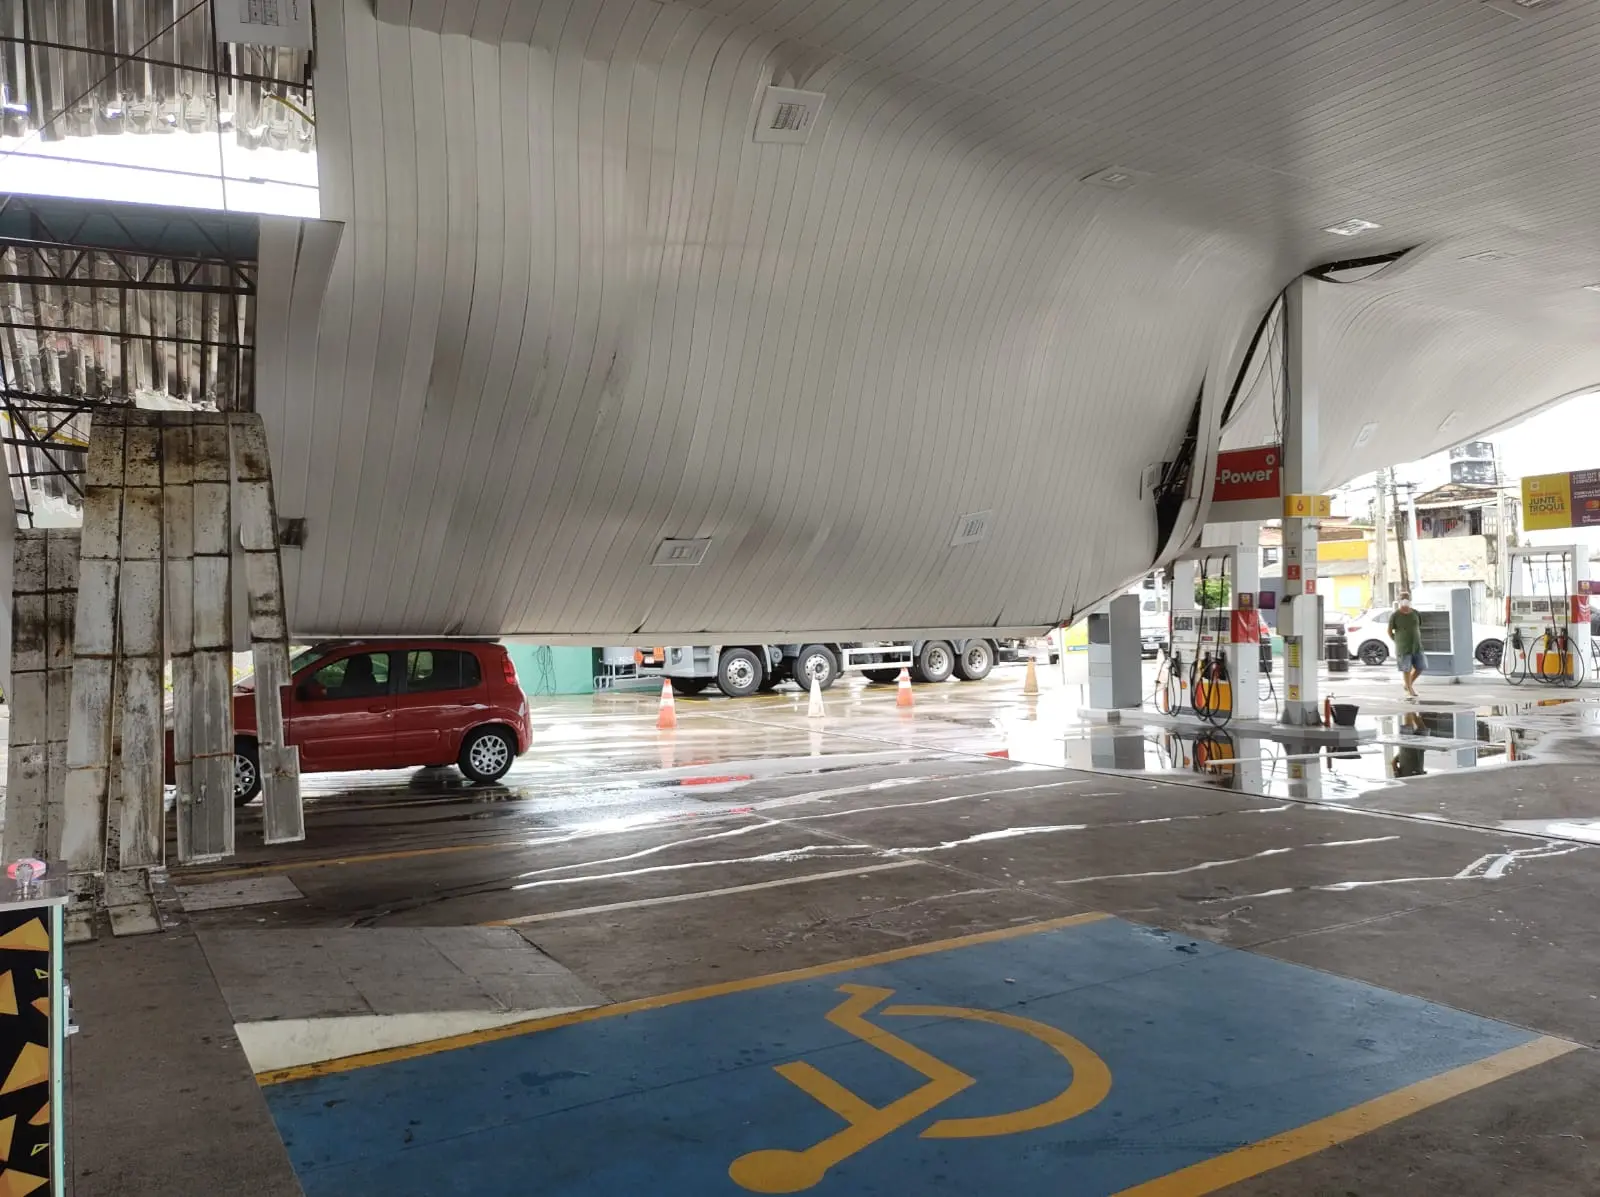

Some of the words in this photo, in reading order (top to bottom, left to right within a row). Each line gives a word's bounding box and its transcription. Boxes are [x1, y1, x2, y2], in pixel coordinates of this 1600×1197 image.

[1216, 469, 1273, 484] -Power
[1297, 500, 1304, 512] 6
[1528, 496, 1556, 505] JUNTE
[1528, 503, 1565, 513] TROQUE
